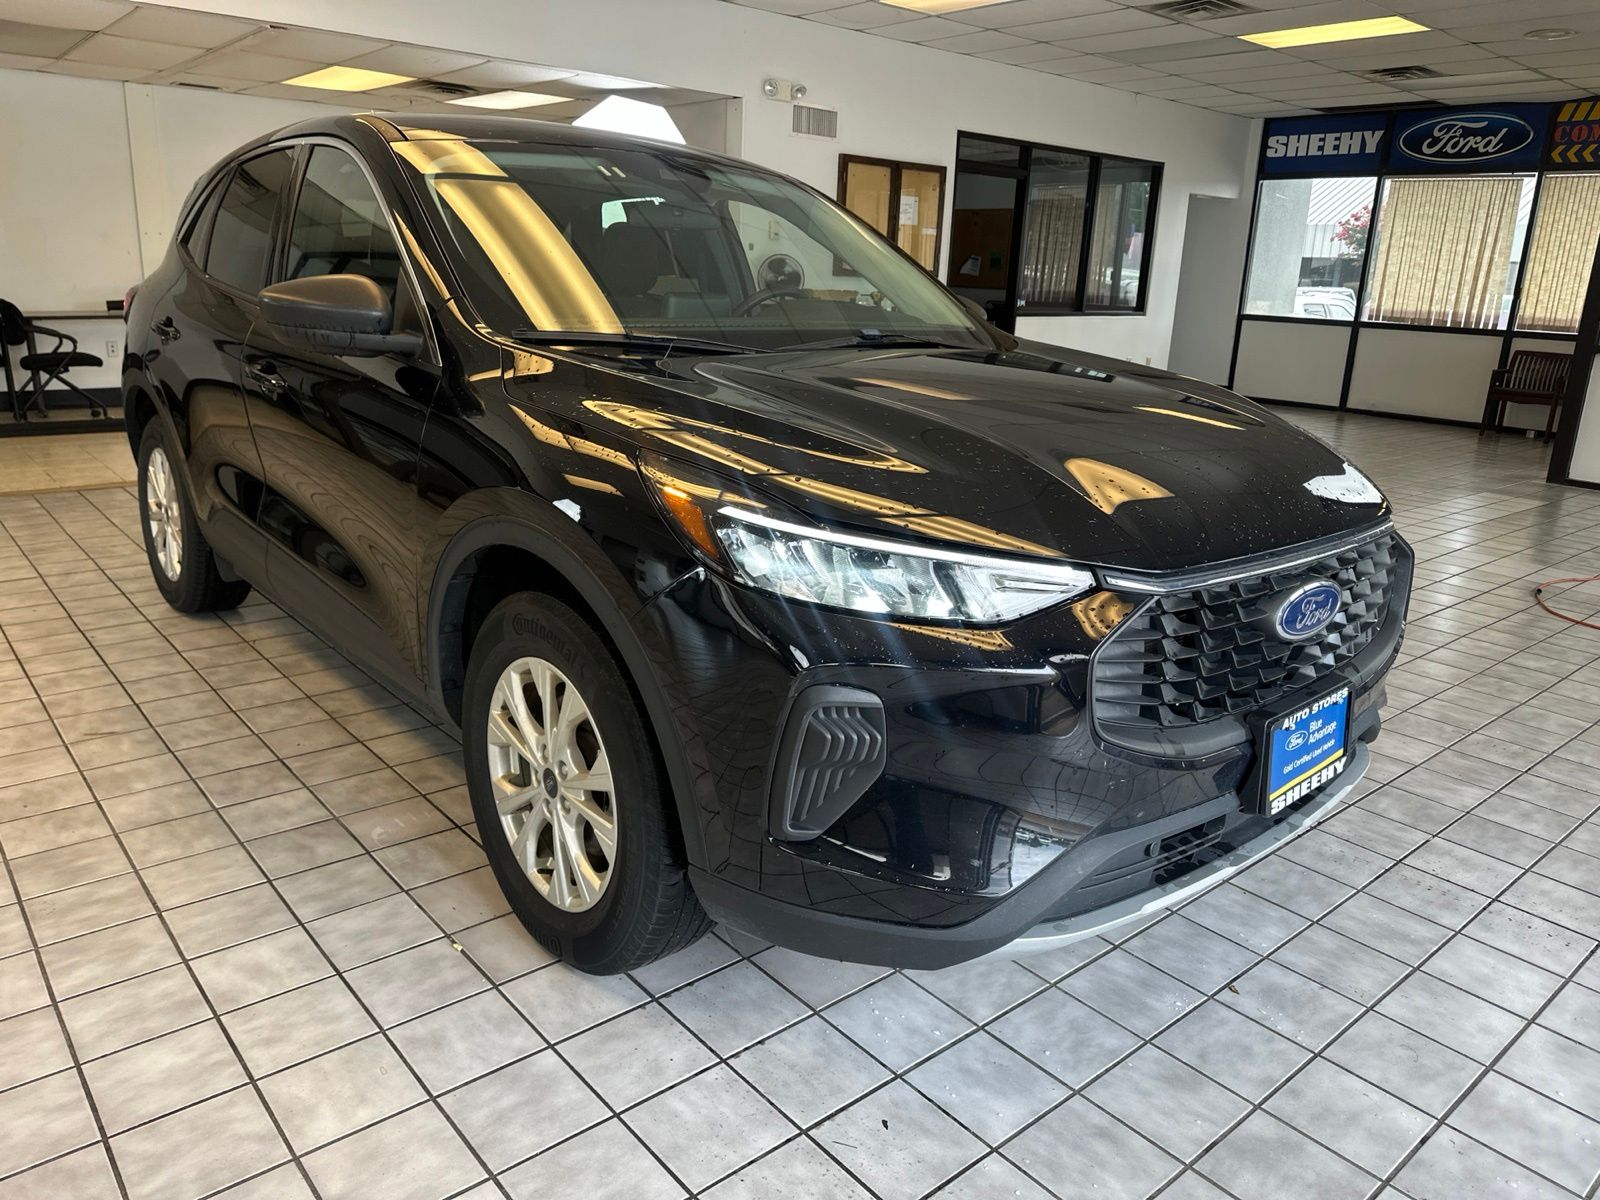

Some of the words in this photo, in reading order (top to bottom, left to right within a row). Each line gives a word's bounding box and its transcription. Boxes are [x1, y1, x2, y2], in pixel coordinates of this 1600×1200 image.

[1266, 130, 1384, 158] SHEEHY
[1421, 120, 1506, 155] Ford
[1296, 594, 1332, 629] Ford
[1282, 708, 1310, 731] AUTO
[1312, 687, 1348, 714] STORES
[1288, 732, 1305, 750] Ford
[1308, 721, 1337, 745] Advantage
[1309, 719, 1323, 733] Blue
[1271, 756, 1348, 815] SHEEHY
